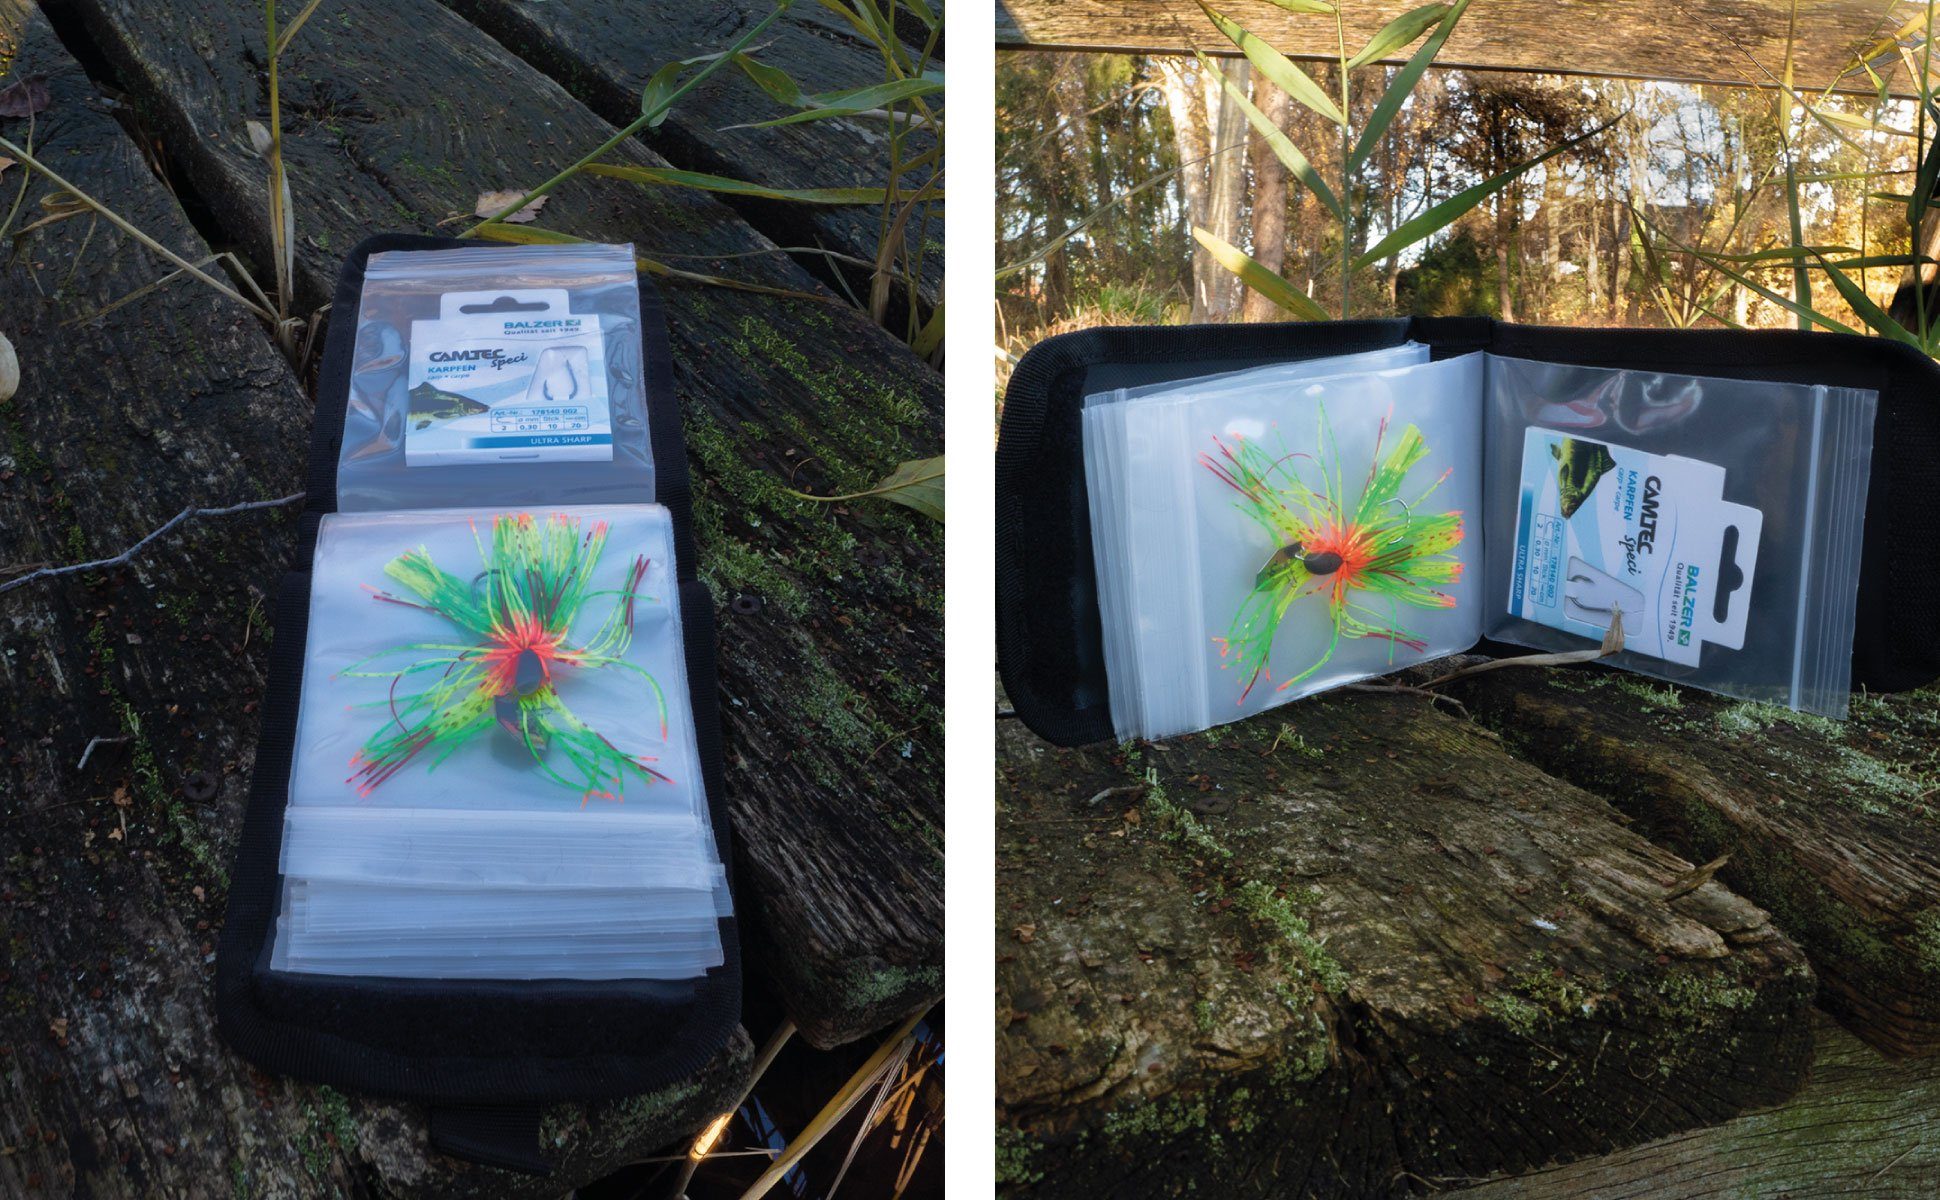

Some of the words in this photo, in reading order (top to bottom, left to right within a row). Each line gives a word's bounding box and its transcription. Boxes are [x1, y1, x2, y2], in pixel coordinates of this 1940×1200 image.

[504, 320, 563, 329] BALZER
[429, 349, 506, 362] CAMTEC
[427, 364, 476, 374] KARPFEN
[561, 436, 592, 444] SHARP
[1616, 467, 1625, 487] carp
[1614, 490, 1622, 512] carpe
[1623, 470, 1638, 521] KARPFEN
[1636, 475, 1662, 555] CAMTEC
[1518, 545, 1527, 570] ULTRA
[1533, 566, 1539, 575] 10
[1548, 556, 1557, 583] 178140
[1674, 562, 1684, 598] Qualität
[1514, 573, 1524, 600] SHARP
[1547, 584, 1555, 598] 002
[1680, 565, 1700, 628] BALZER
[1670, 600, 1678, 617] seit
